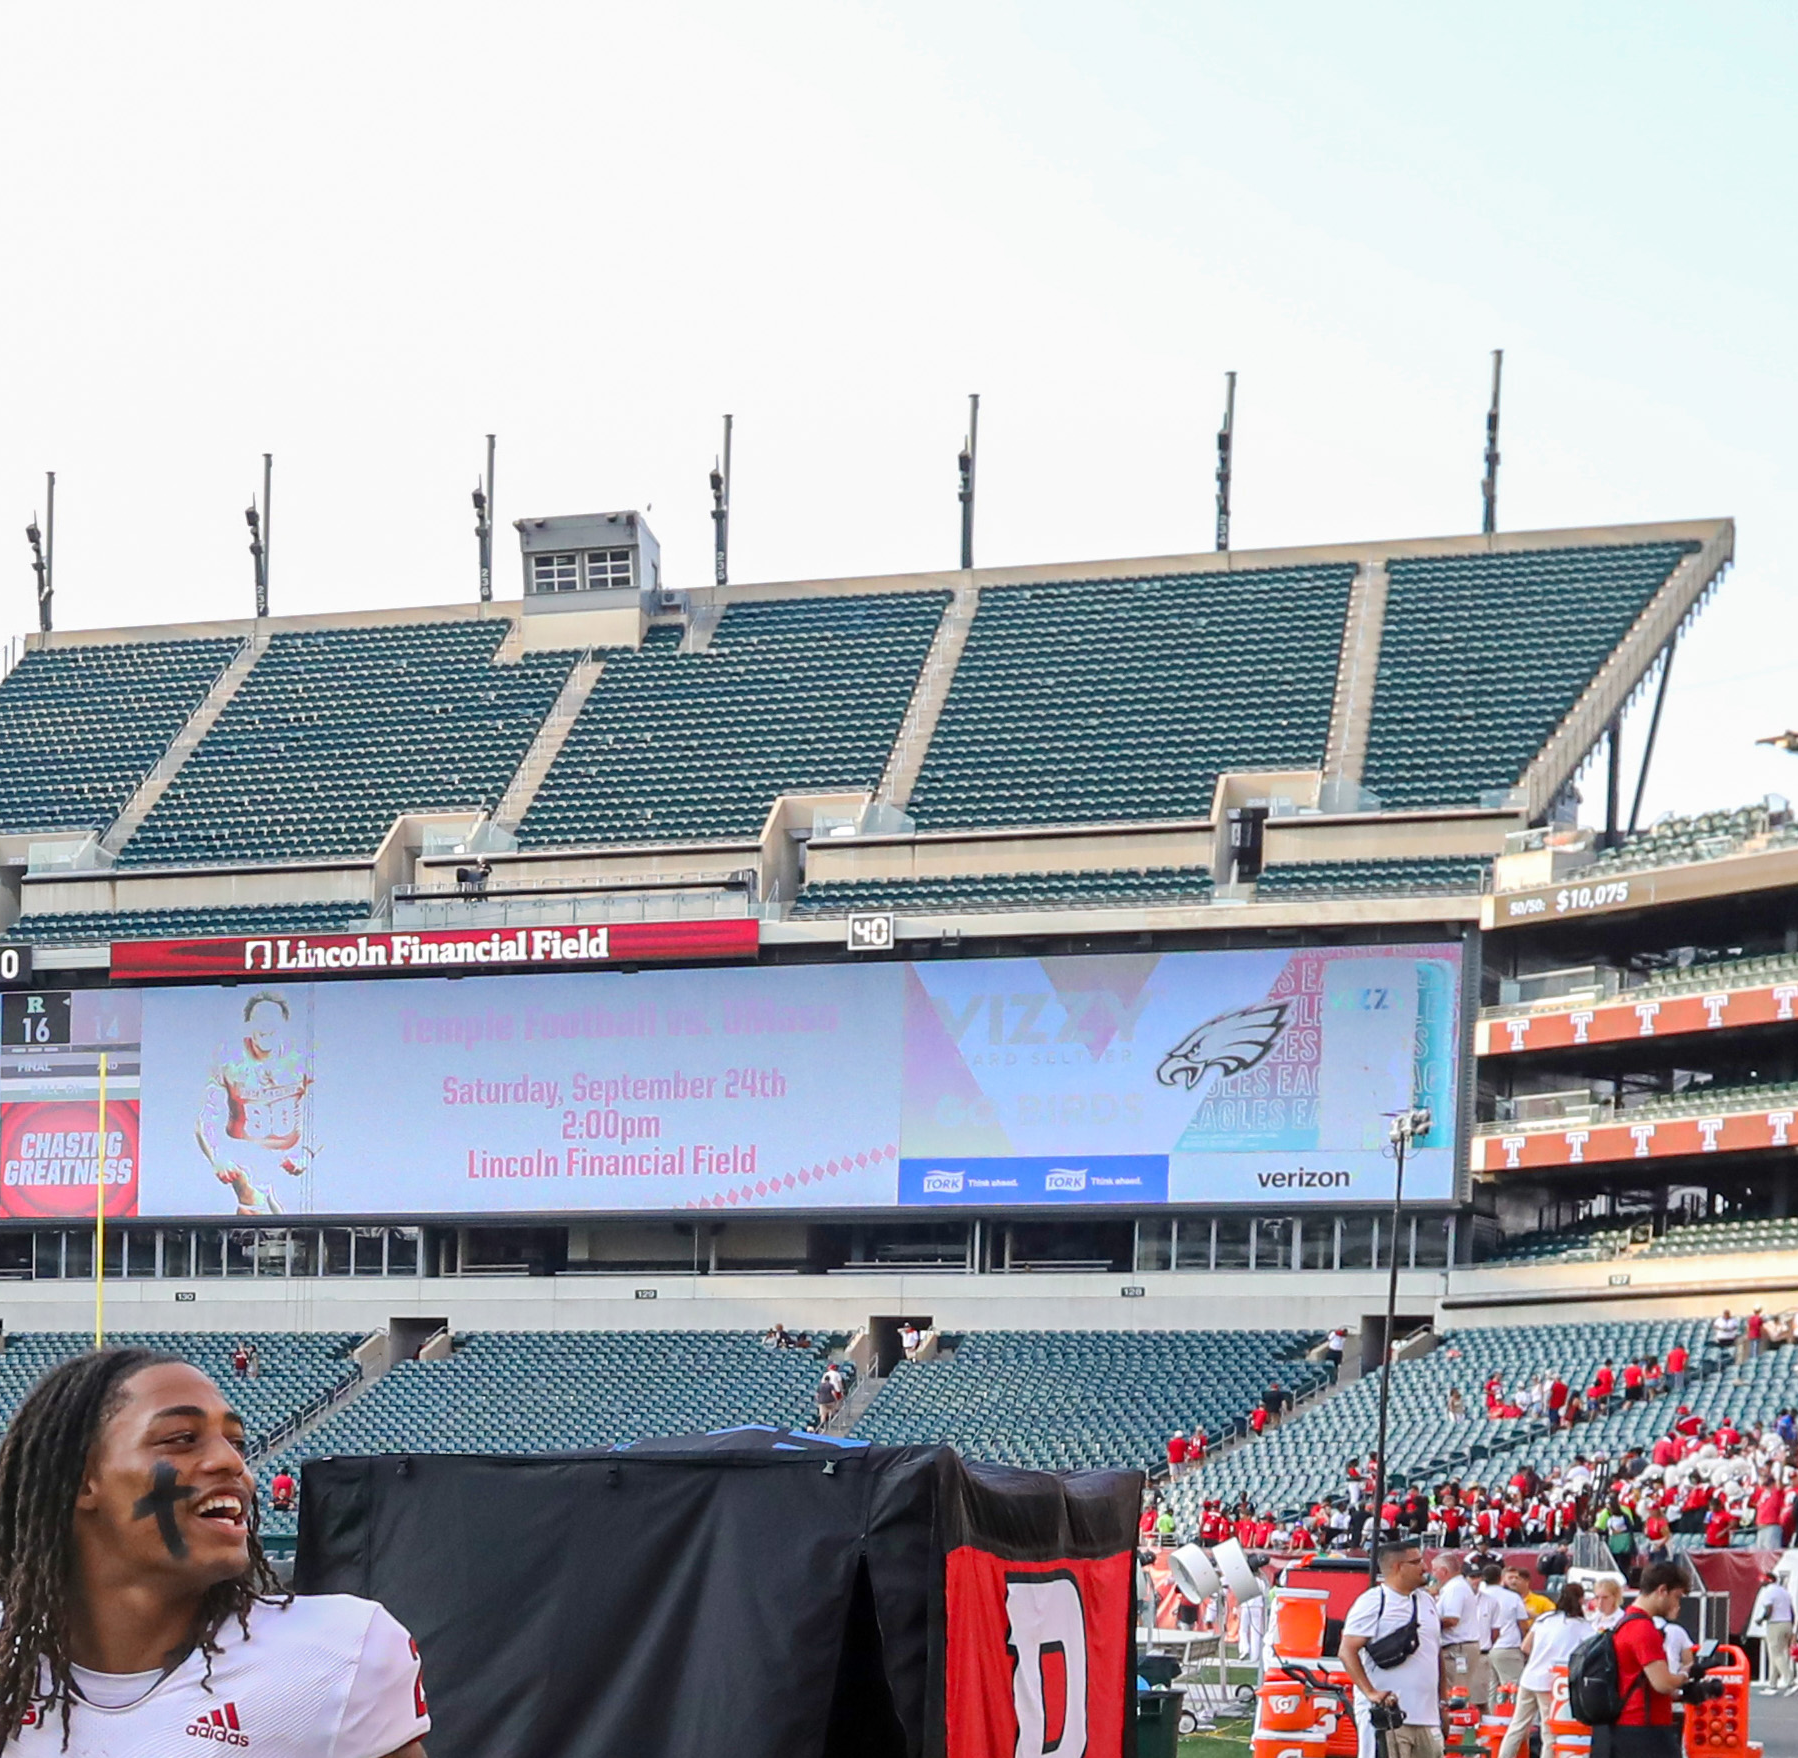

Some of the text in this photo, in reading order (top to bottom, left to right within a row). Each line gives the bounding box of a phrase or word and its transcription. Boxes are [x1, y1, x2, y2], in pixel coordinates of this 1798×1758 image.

[1510, 882, 1629, 916] 50/50: $10,075
[854, 917, 888, 945] 40
[277, 927, 609, 970] Lincoln Financial Field
[27, 997, 46, 1013] R
[931, 991, 1151, 1045] VIZZY
[23, 1017, 50, 1042] 16
[402, 1008, 514, 1051] Temple
[525, 1001, 657, 1041] Football
[1032, 1049, 1132, 1066] SELTER
[443, 1067, 787, 1109] Saturday, September 24th
[563, 1109, 661, 1145] 2:00pm
[5, 1158, 133, 1186] GREATNESS
[468, 1144, 757, 1179] Lincoln Financial Field
[925, 1178, 961, 1190] TORK
[968, 1178, 990, 1187] Think
[1047, 1176, 1083, 1190] TORK
[1091, 1176, 1112, 1186] Think
[1257, 1166, 1351, 1188] verizon
[186, 1721, 250, 1748] adidas
